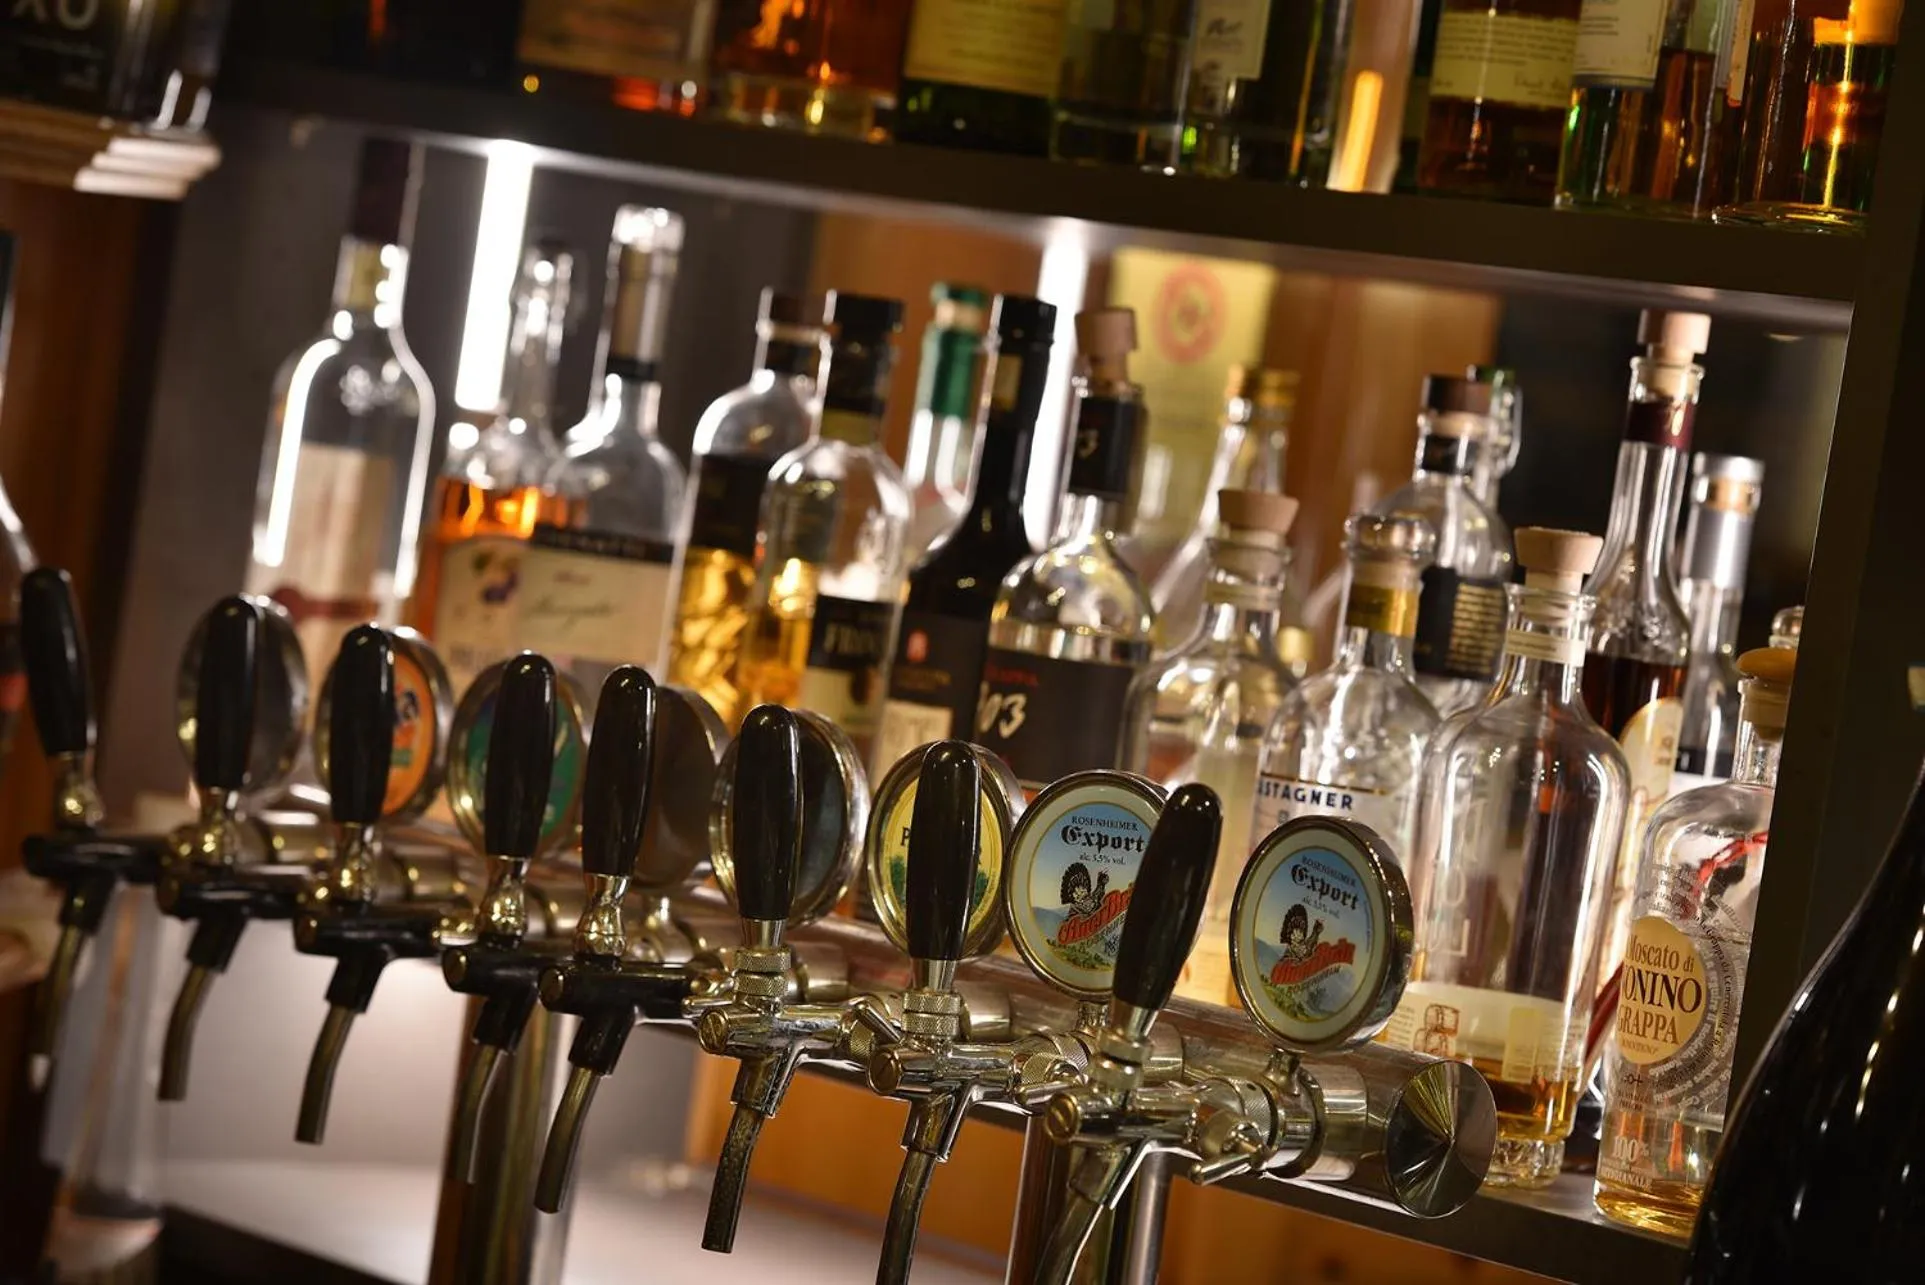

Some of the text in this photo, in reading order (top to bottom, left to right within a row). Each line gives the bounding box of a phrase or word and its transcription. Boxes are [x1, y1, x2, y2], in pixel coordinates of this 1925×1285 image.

[1061, 825, 1145, 853] Export
[1072, 816, 1138, 831] ROSENHEIMER
[1291, 864, 1358, 911] Export
[1302, 854, 1356, 888] ROSENHEIMER
[1625, 935, 1695, 973] Moscato di
[1623, 964, 1703, 1014] ONINO
[1617, 1004, 1680, 1046] GRAPPA
